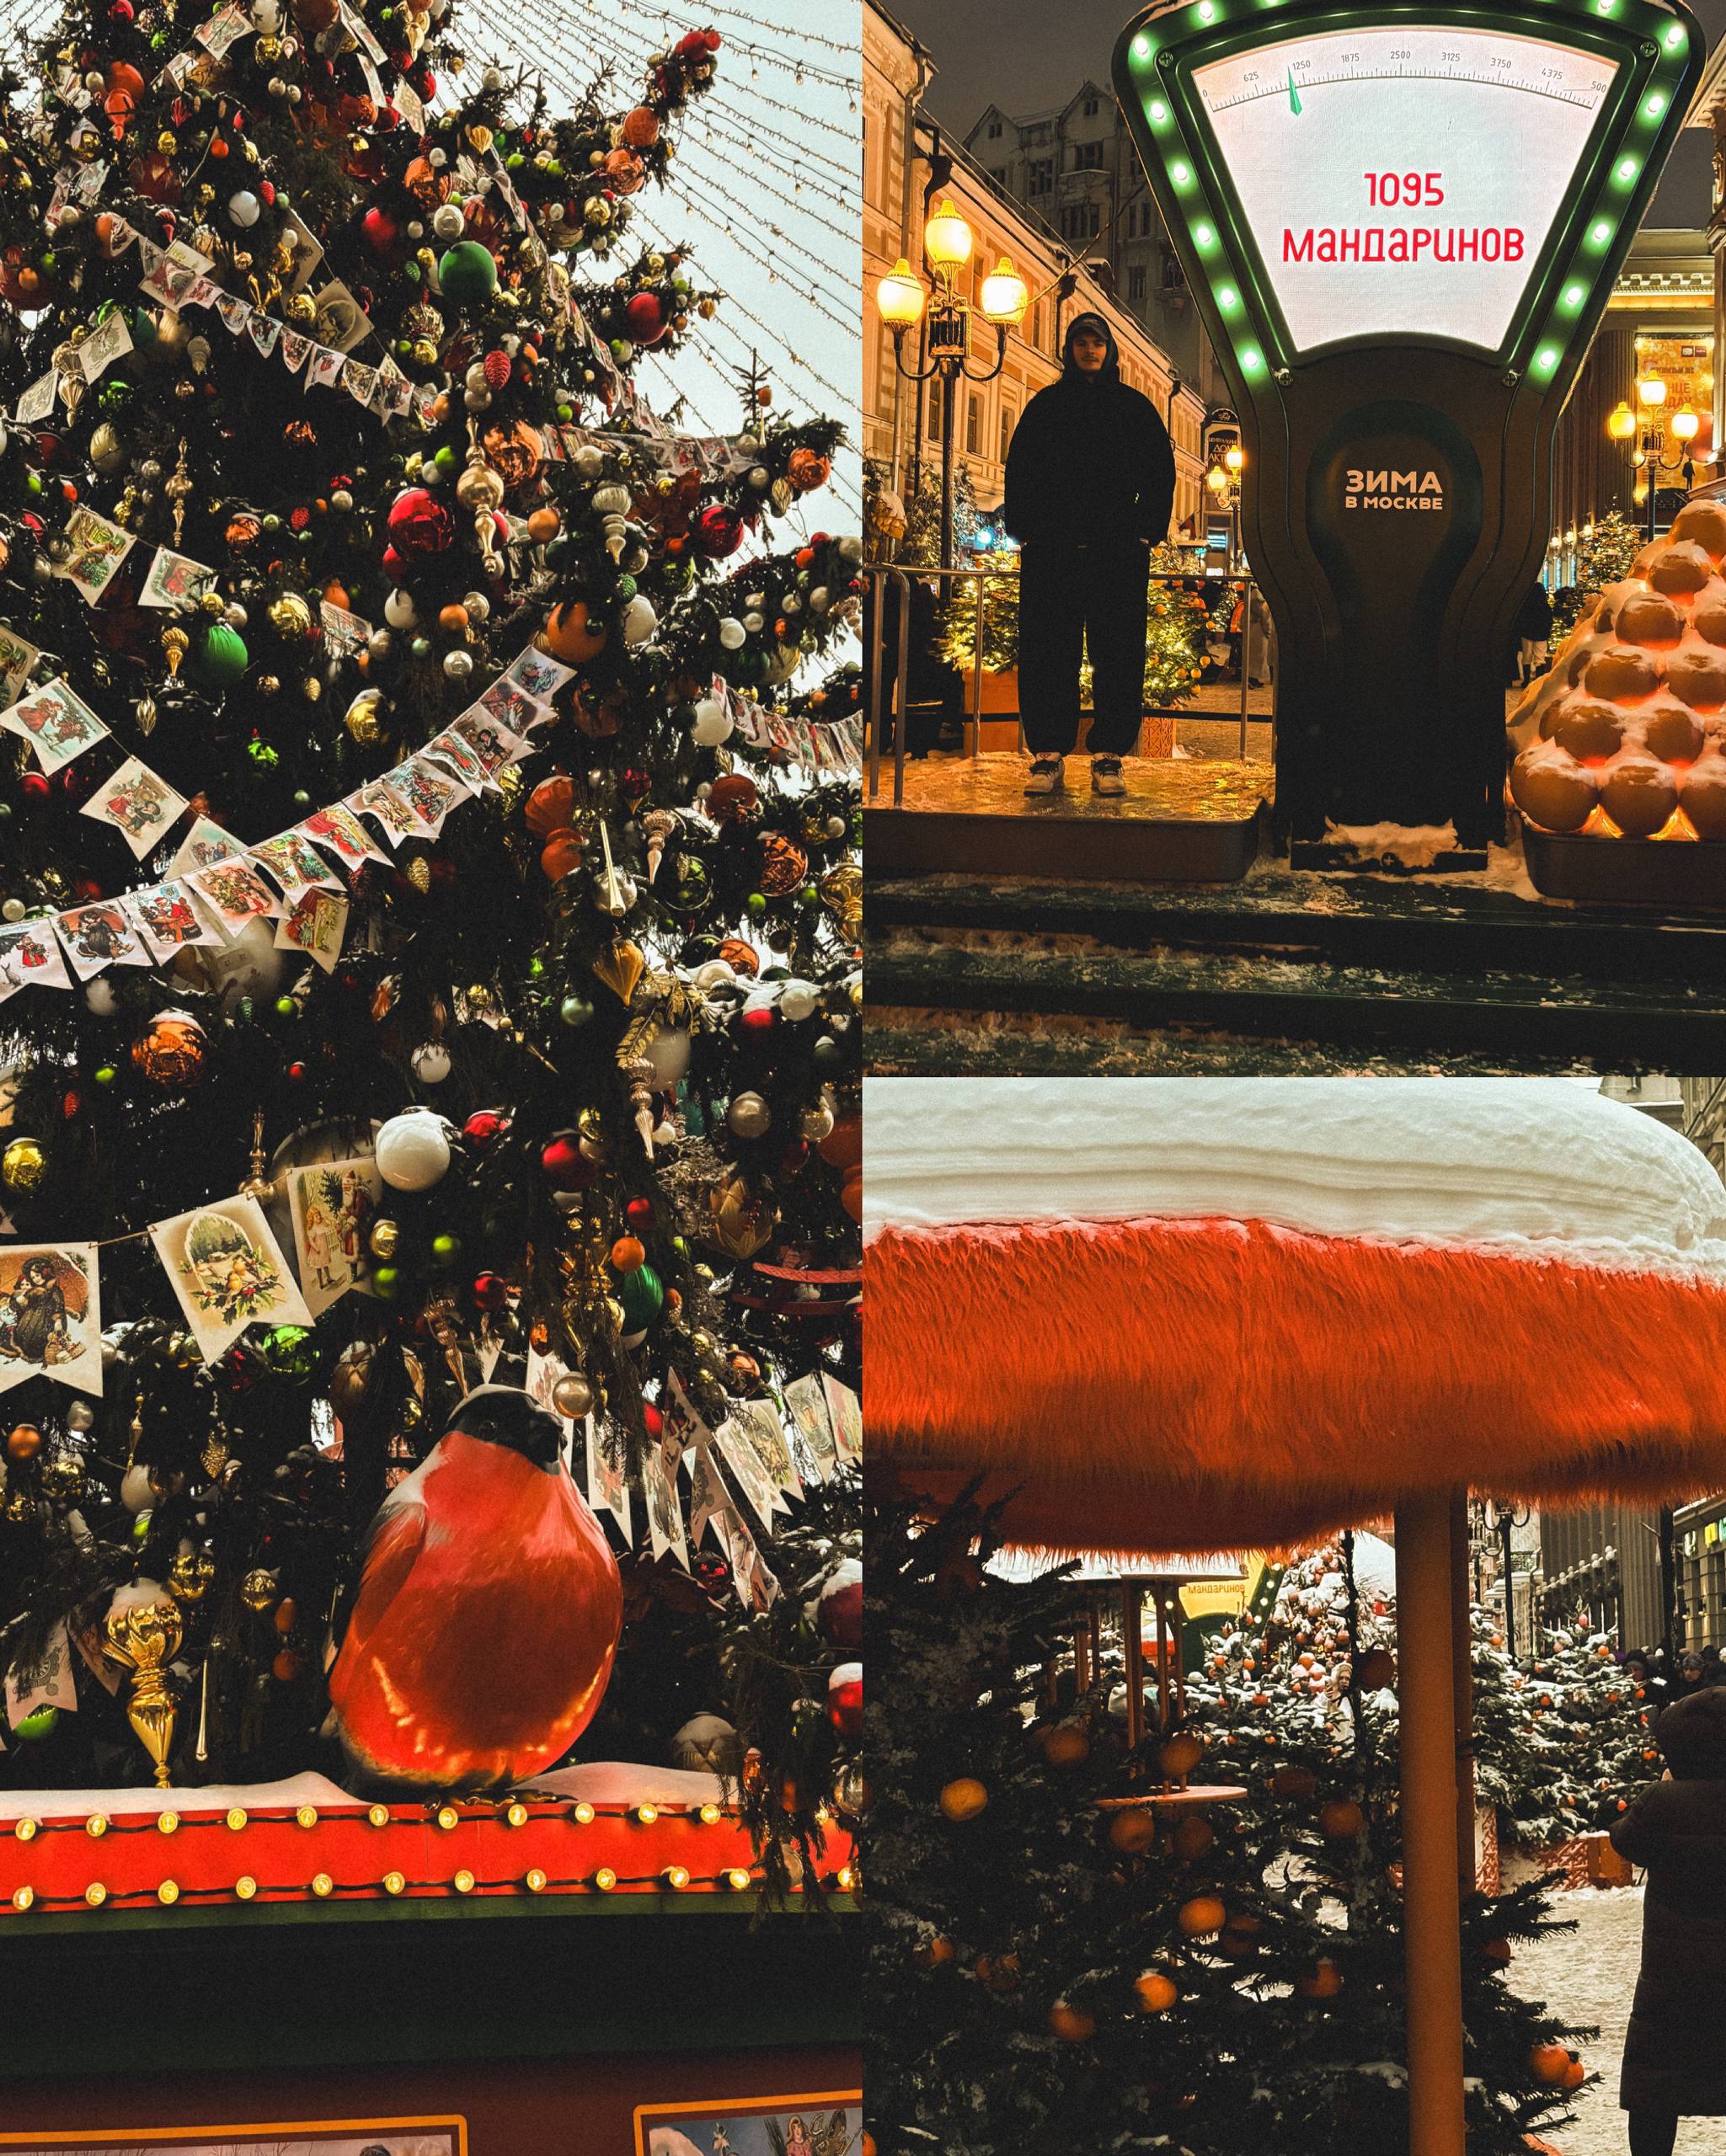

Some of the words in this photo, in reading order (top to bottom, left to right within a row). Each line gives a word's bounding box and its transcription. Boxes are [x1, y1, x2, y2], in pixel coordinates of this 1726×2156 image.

[1243, 71, 1259, 83] 625
[1292, 59, 1311, 71] 1250
[1341, 52, 1360, 63] 1875
[1390, 51, 1411, 60] 2500
[1441, 51, 1461, 62] 3125
[1490, 57, 1512, 69] 3750
[1541, 67, 1564, 81] 4375
[1364, 172, 1445, 207] 1095
[1282, 228, 1525, 263] МАНДАРИНОВ
[1345, 469, 1443, 494] ЗИМА
[1345, 496, 1358, 509] В
[1363, 496, 1443, 510] МОСКВЕ
